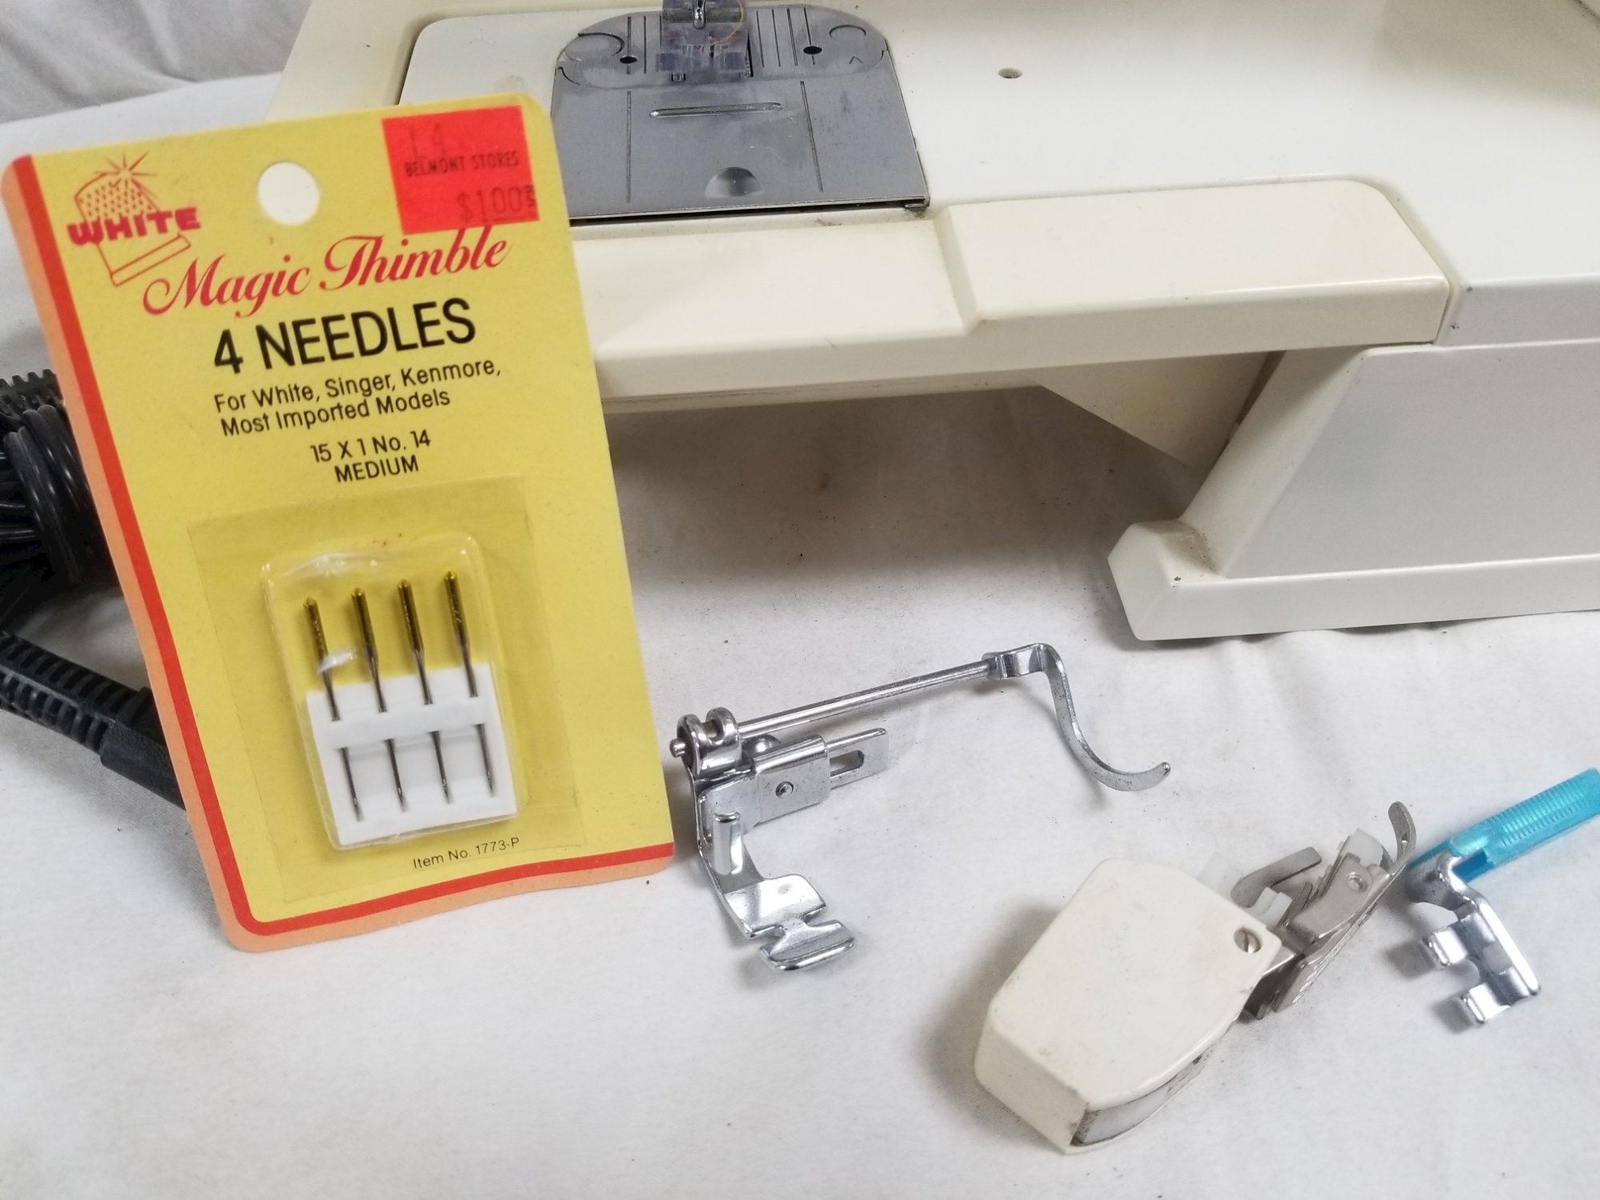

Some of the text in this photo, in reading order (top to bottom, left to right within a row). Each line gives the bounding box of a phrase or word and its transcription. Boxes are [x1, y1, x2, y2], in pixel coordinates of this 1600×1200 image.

[404, 150, 520, 178] BELMONT STORES
[67, 206, 202, 246] WHITE
[143, 225, 513, 318] Magic Thimble
[213, 297, 477, 374] 4 NEEDLES
[214, 359, 502, 413] For White, Singer, Kenmore,
[220, 388, 451, 437] Most Imported Models
[310, 443, 333, 463] 15
[356, 438, 367, 456] 1
[372, 434, 407, 454] No.
[410, 429, 432, 448] 14
[334, 454, 420, 483] MEDIUM
[412, 836, 520, 869] Item No. 1773-P
